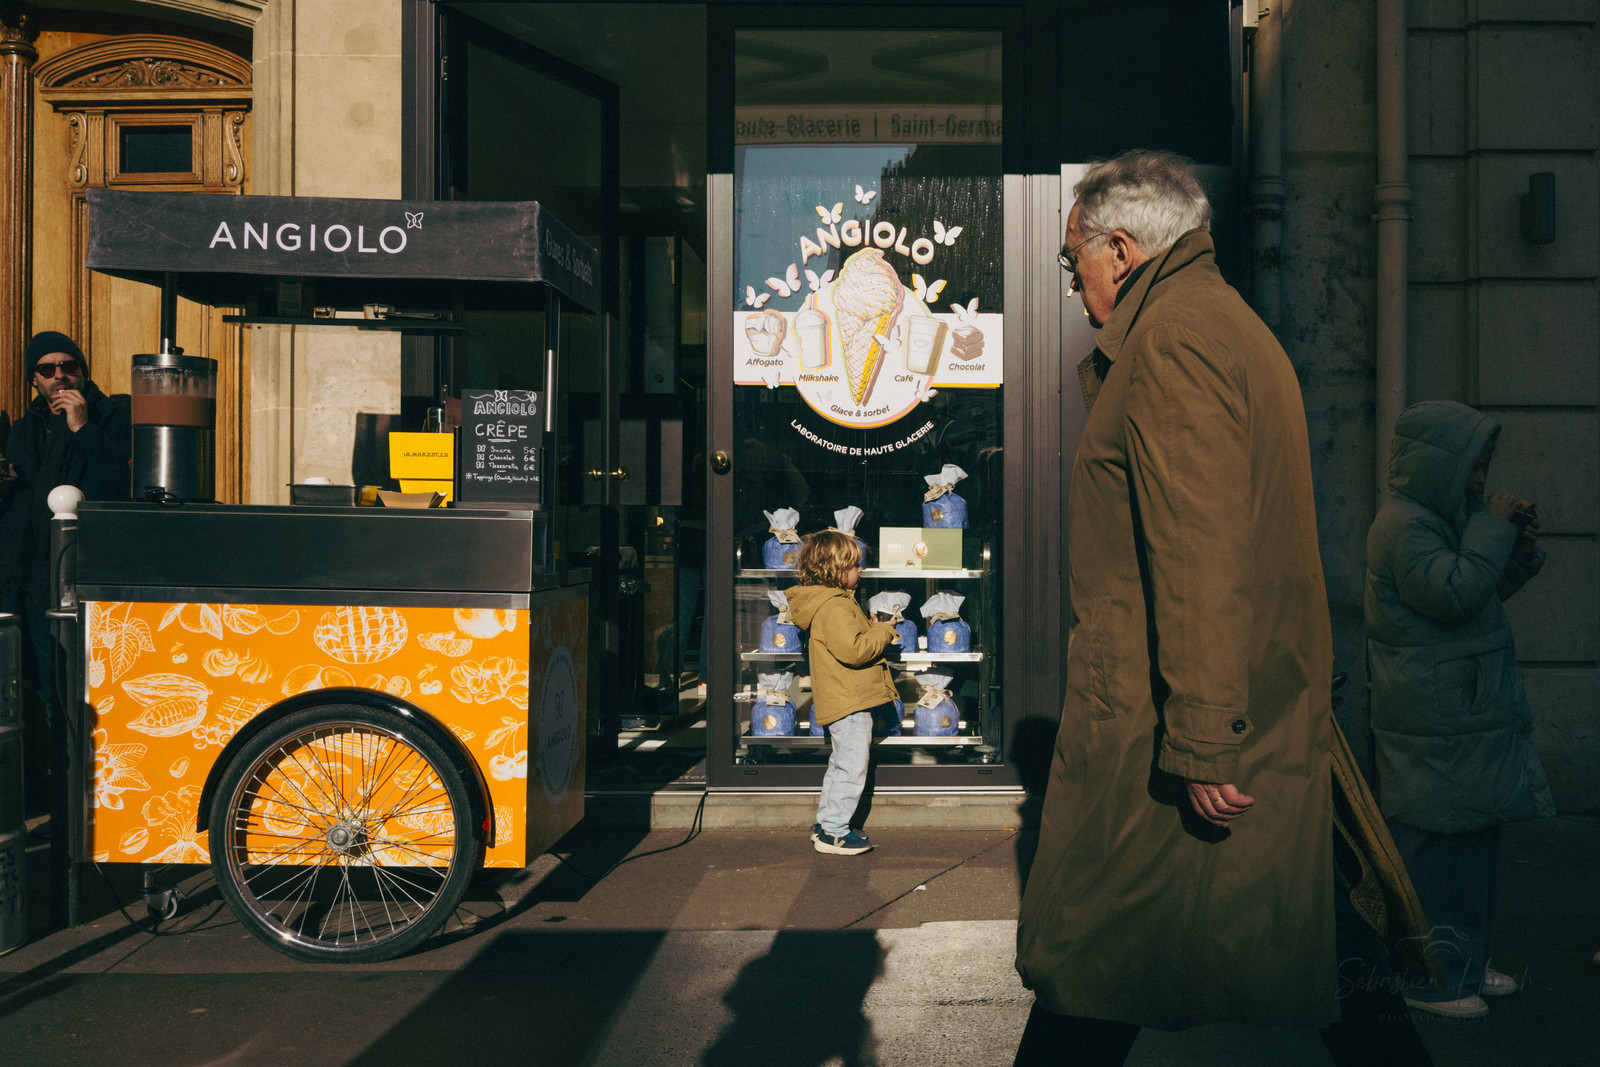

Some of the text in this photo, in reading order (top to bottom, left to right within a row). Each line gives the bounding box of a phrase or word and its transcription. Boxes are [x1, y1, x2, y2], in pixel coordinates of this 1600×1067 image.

[209, 221, 408, 254] ANGIOLO
[799, 219, 935, 266] ANGIOLO
[745, 357, 784, 367] Affogato
[948, 362, 986, 372] Chocolat
[798, 373, 840, 383] Milkshake
[894, 373, 914, 383] Café
[830, 403, 890, 418] Glace & sorbet
[475, 420, 528, 438] CRÊPE
[790, 418, 935, 456] LABORATOIRE DE HAUTE GLACERIE
[523, 446, 536, 454] 5€
[523, 454, 536, 462] 6€
[523, 463, 535, 471] 6€
